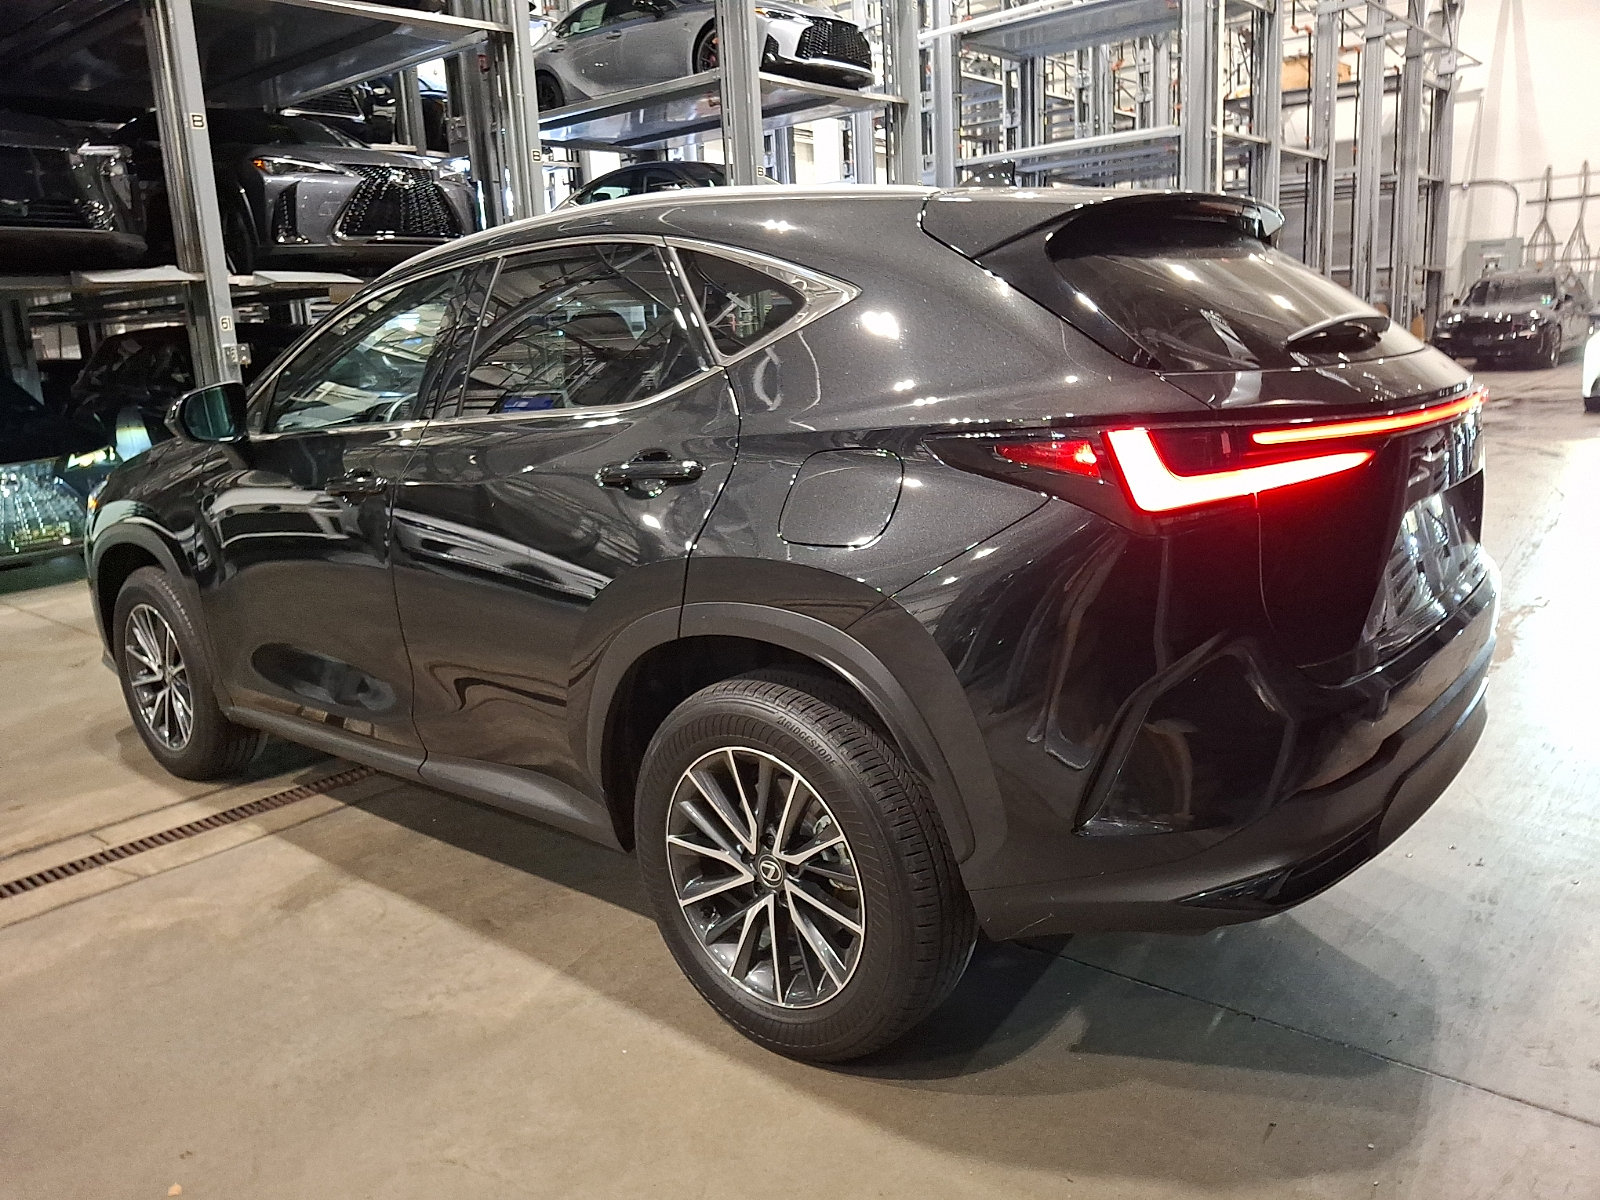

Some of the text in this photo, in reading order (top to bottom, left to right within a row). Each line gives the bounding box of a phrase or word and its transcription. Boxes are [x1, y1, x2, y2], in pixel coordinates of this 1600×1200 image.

[191, 114, 204, 128] B
[532, 150, 541, 161] B
[776, 715, 838, 766] BRIDGESTONE
